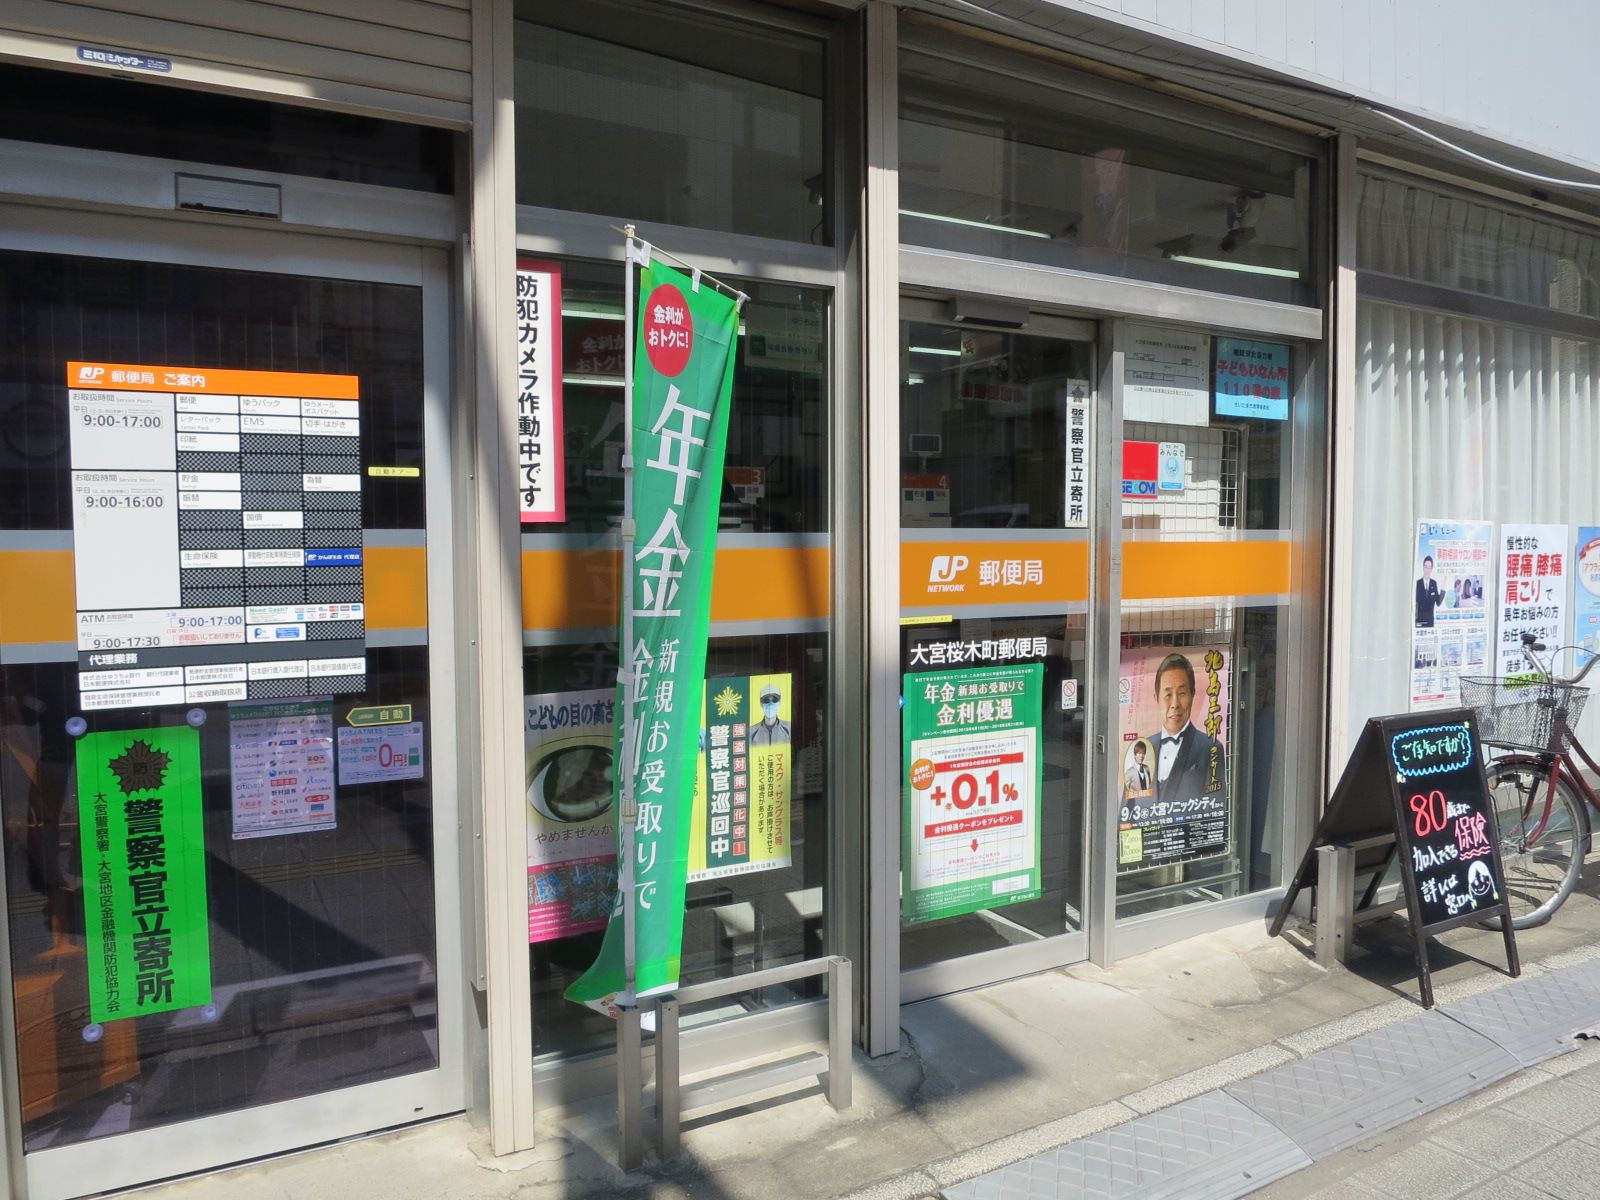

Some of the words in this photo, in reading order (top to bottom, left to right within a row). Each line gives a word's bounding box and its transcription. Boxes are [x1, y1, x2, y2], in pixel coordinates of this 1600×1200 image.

[653, 304, 684, 324] 金利が
[648, 328, 689, 349] おトクに!
[111, 370, 155, 385] 郵便局
[164, 373, 206, 387] ご案内
[516, 274, 542, 507] 防犯カメラ作動中です
[84, 414, 162, 428] 9:00-17:00
[243, 418, 265, 426] EMS
[1070, 408, 1085, 521] 警察官立寄所
[86, 496, 164, 508] 9:00-16:00
[632, 383, 711, 617] 年金
[929, 555, 969, 583] JP
[979, 560, 1044, 587] 郵便局
[1506, 554, 1533, 579] 腰痛
[927, 584, 966, 593] NETWORK
[1504, 579, 1542, 605] 肩こり
[81, 615, 105, 624] ATM
[178, 615, 242, 628] 9:00-17:00
[93, 636, 160, 648] 9:00-17:30
[909, 636, 1048, 666] 大宮桜木町郵便局
[89, 653, 138, 666] 代理業務
[924, 681, 956, 705] 年金
[958, 680, 1025, 697] 新規お受取りで
[936, 697, 1013, 727] 金利優遇
[634, 637, 680, 910] 新規お受取りで
[709, 724, 730, 859] 警察官巡回中
[1149, 796, 1216, 818] 大宮ソニックシティ
[535, 823, 614, 846] やめませんか
[1454, 811, 1490, 851] 保険
[1413, 843, 1459, 873] 加入できる
[123, 798, 175, 1007] 警察官立寄所
